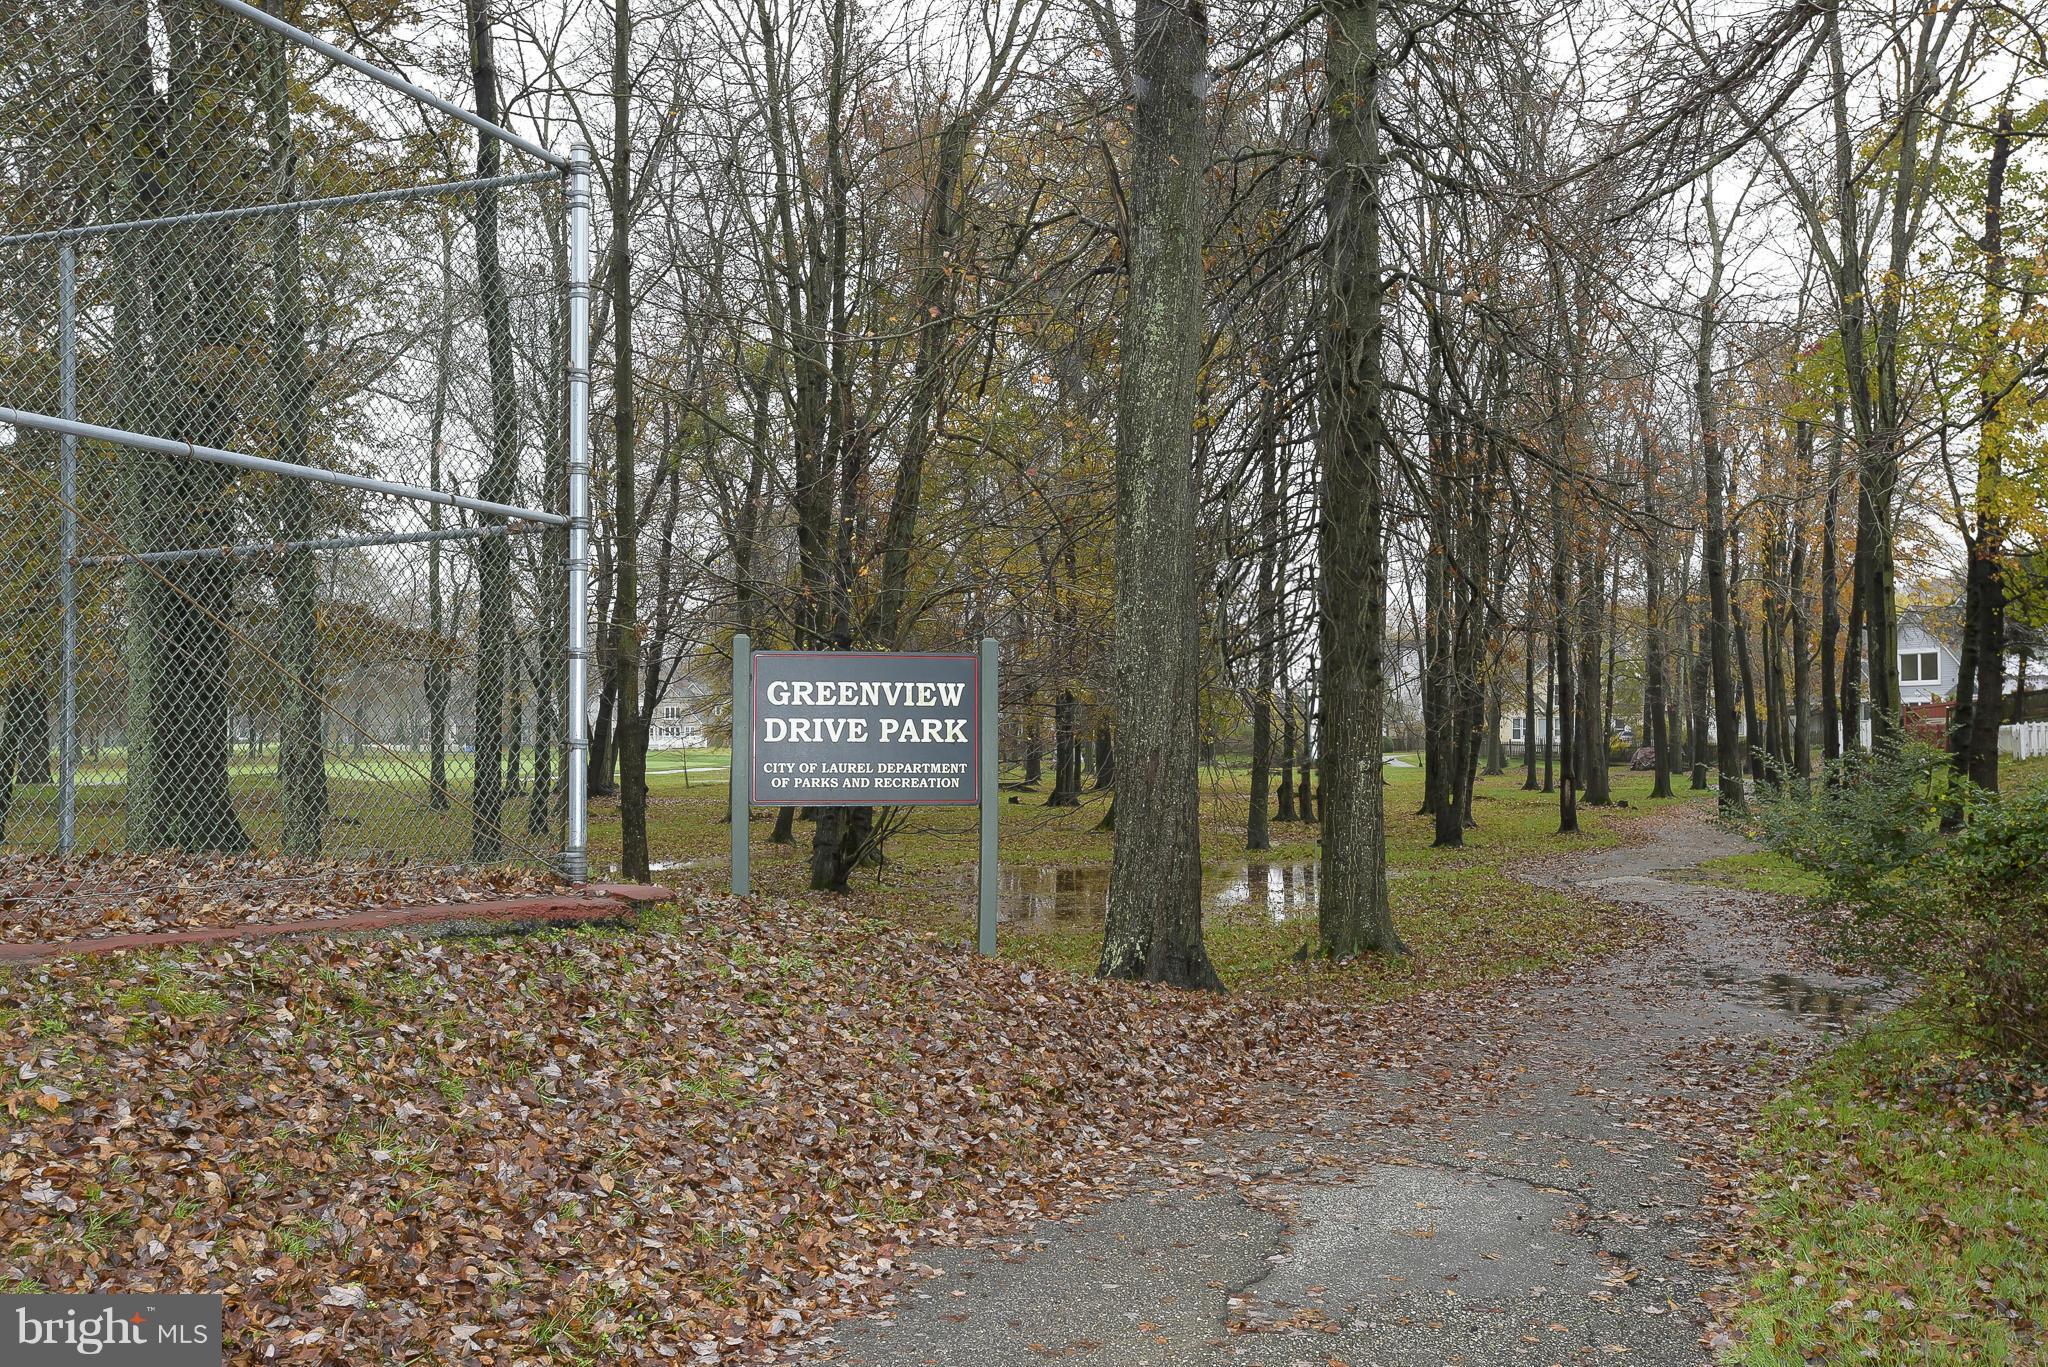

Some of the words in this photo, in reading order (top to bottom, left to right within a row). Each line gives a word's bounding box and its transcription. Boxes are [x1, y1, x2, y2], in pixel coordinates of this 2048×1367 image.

[766, 680, 966, 707] GREENVIEW
[763, 717, 869, 743] DRIVE
[878, 718, 969, 744] PARK
[763, 762, 796, 774] CITY
[799, 762, 818, 774] OF
[821, 762, 874, 774] LAUREL
[877, 762, 968, 774] DEPARTMENT
[771, 777, 790, 788] OF
[794, 777, 839, 788] PARKS
[842, 777, 870, 788] AND
[874, 777, 960, 788] RECREATION
